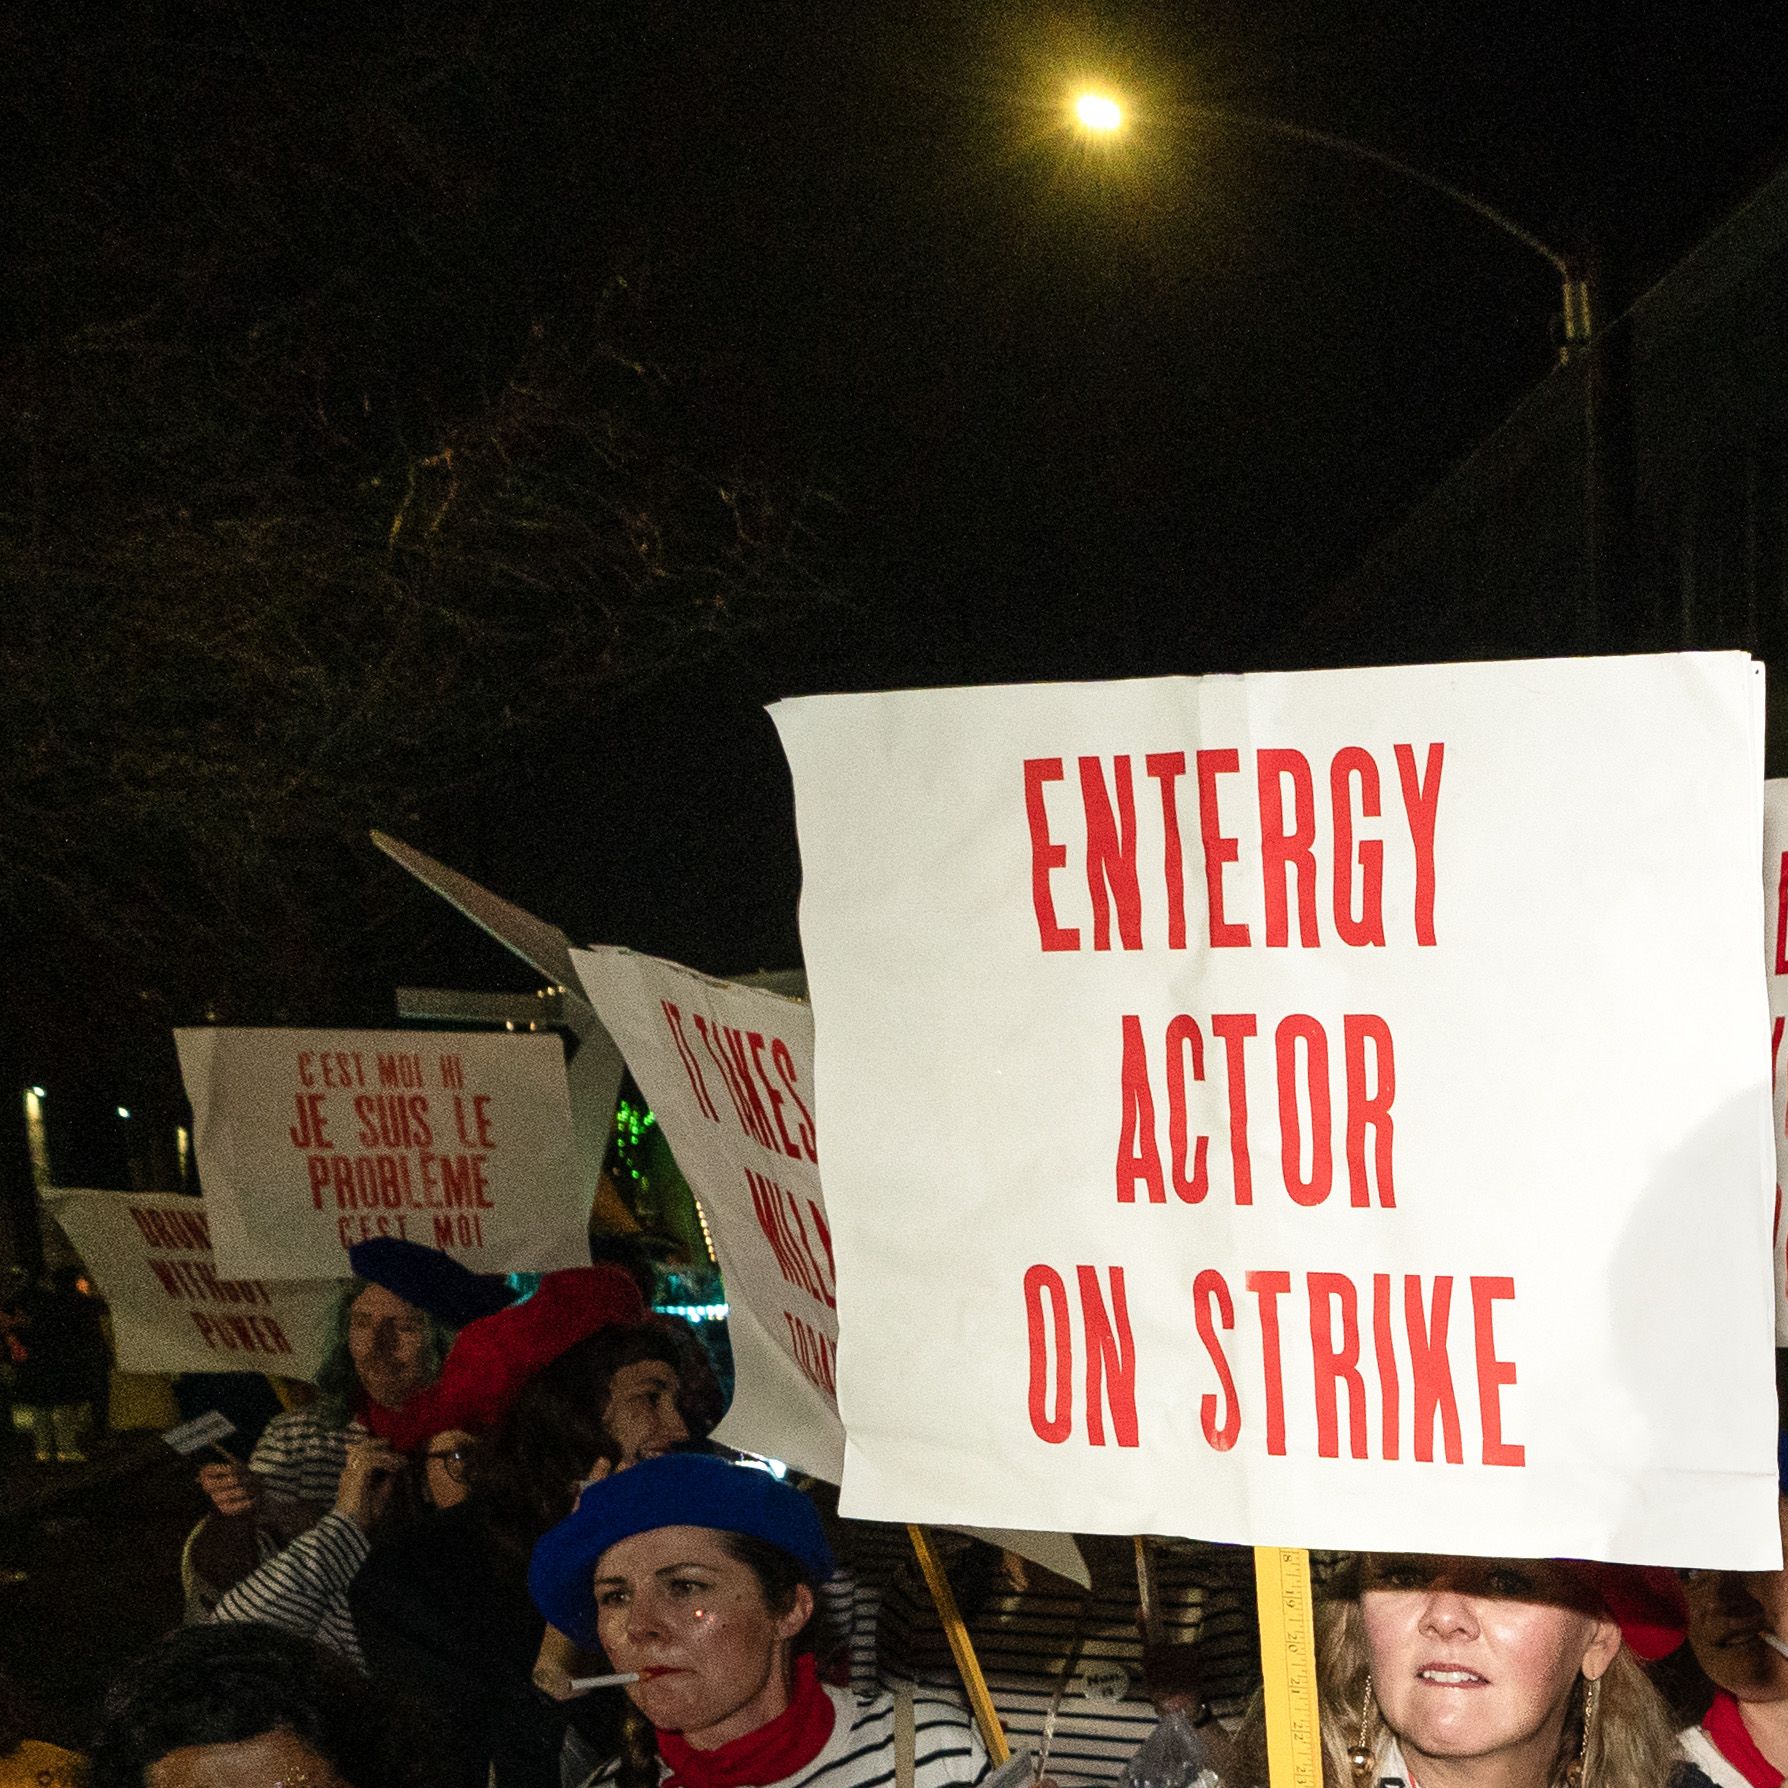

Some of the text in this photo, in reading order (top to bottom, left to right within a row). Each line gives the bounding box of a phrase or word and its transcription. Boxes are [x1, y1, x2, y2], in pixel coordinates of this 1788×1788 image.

[1023, 742, 1446, 953] ENTERGY
[290, 1093, 496, 1149] JE SUIS LE
[378, 1053, 423, 1088] MOI
[661, 1000, 720, 1123] IT
[1116, 1014, 1397, 1208] ACTOR
[433, 1214, 483, 1248] MOI
[1023, 1264, 1525, 1467] ON STRIKE
